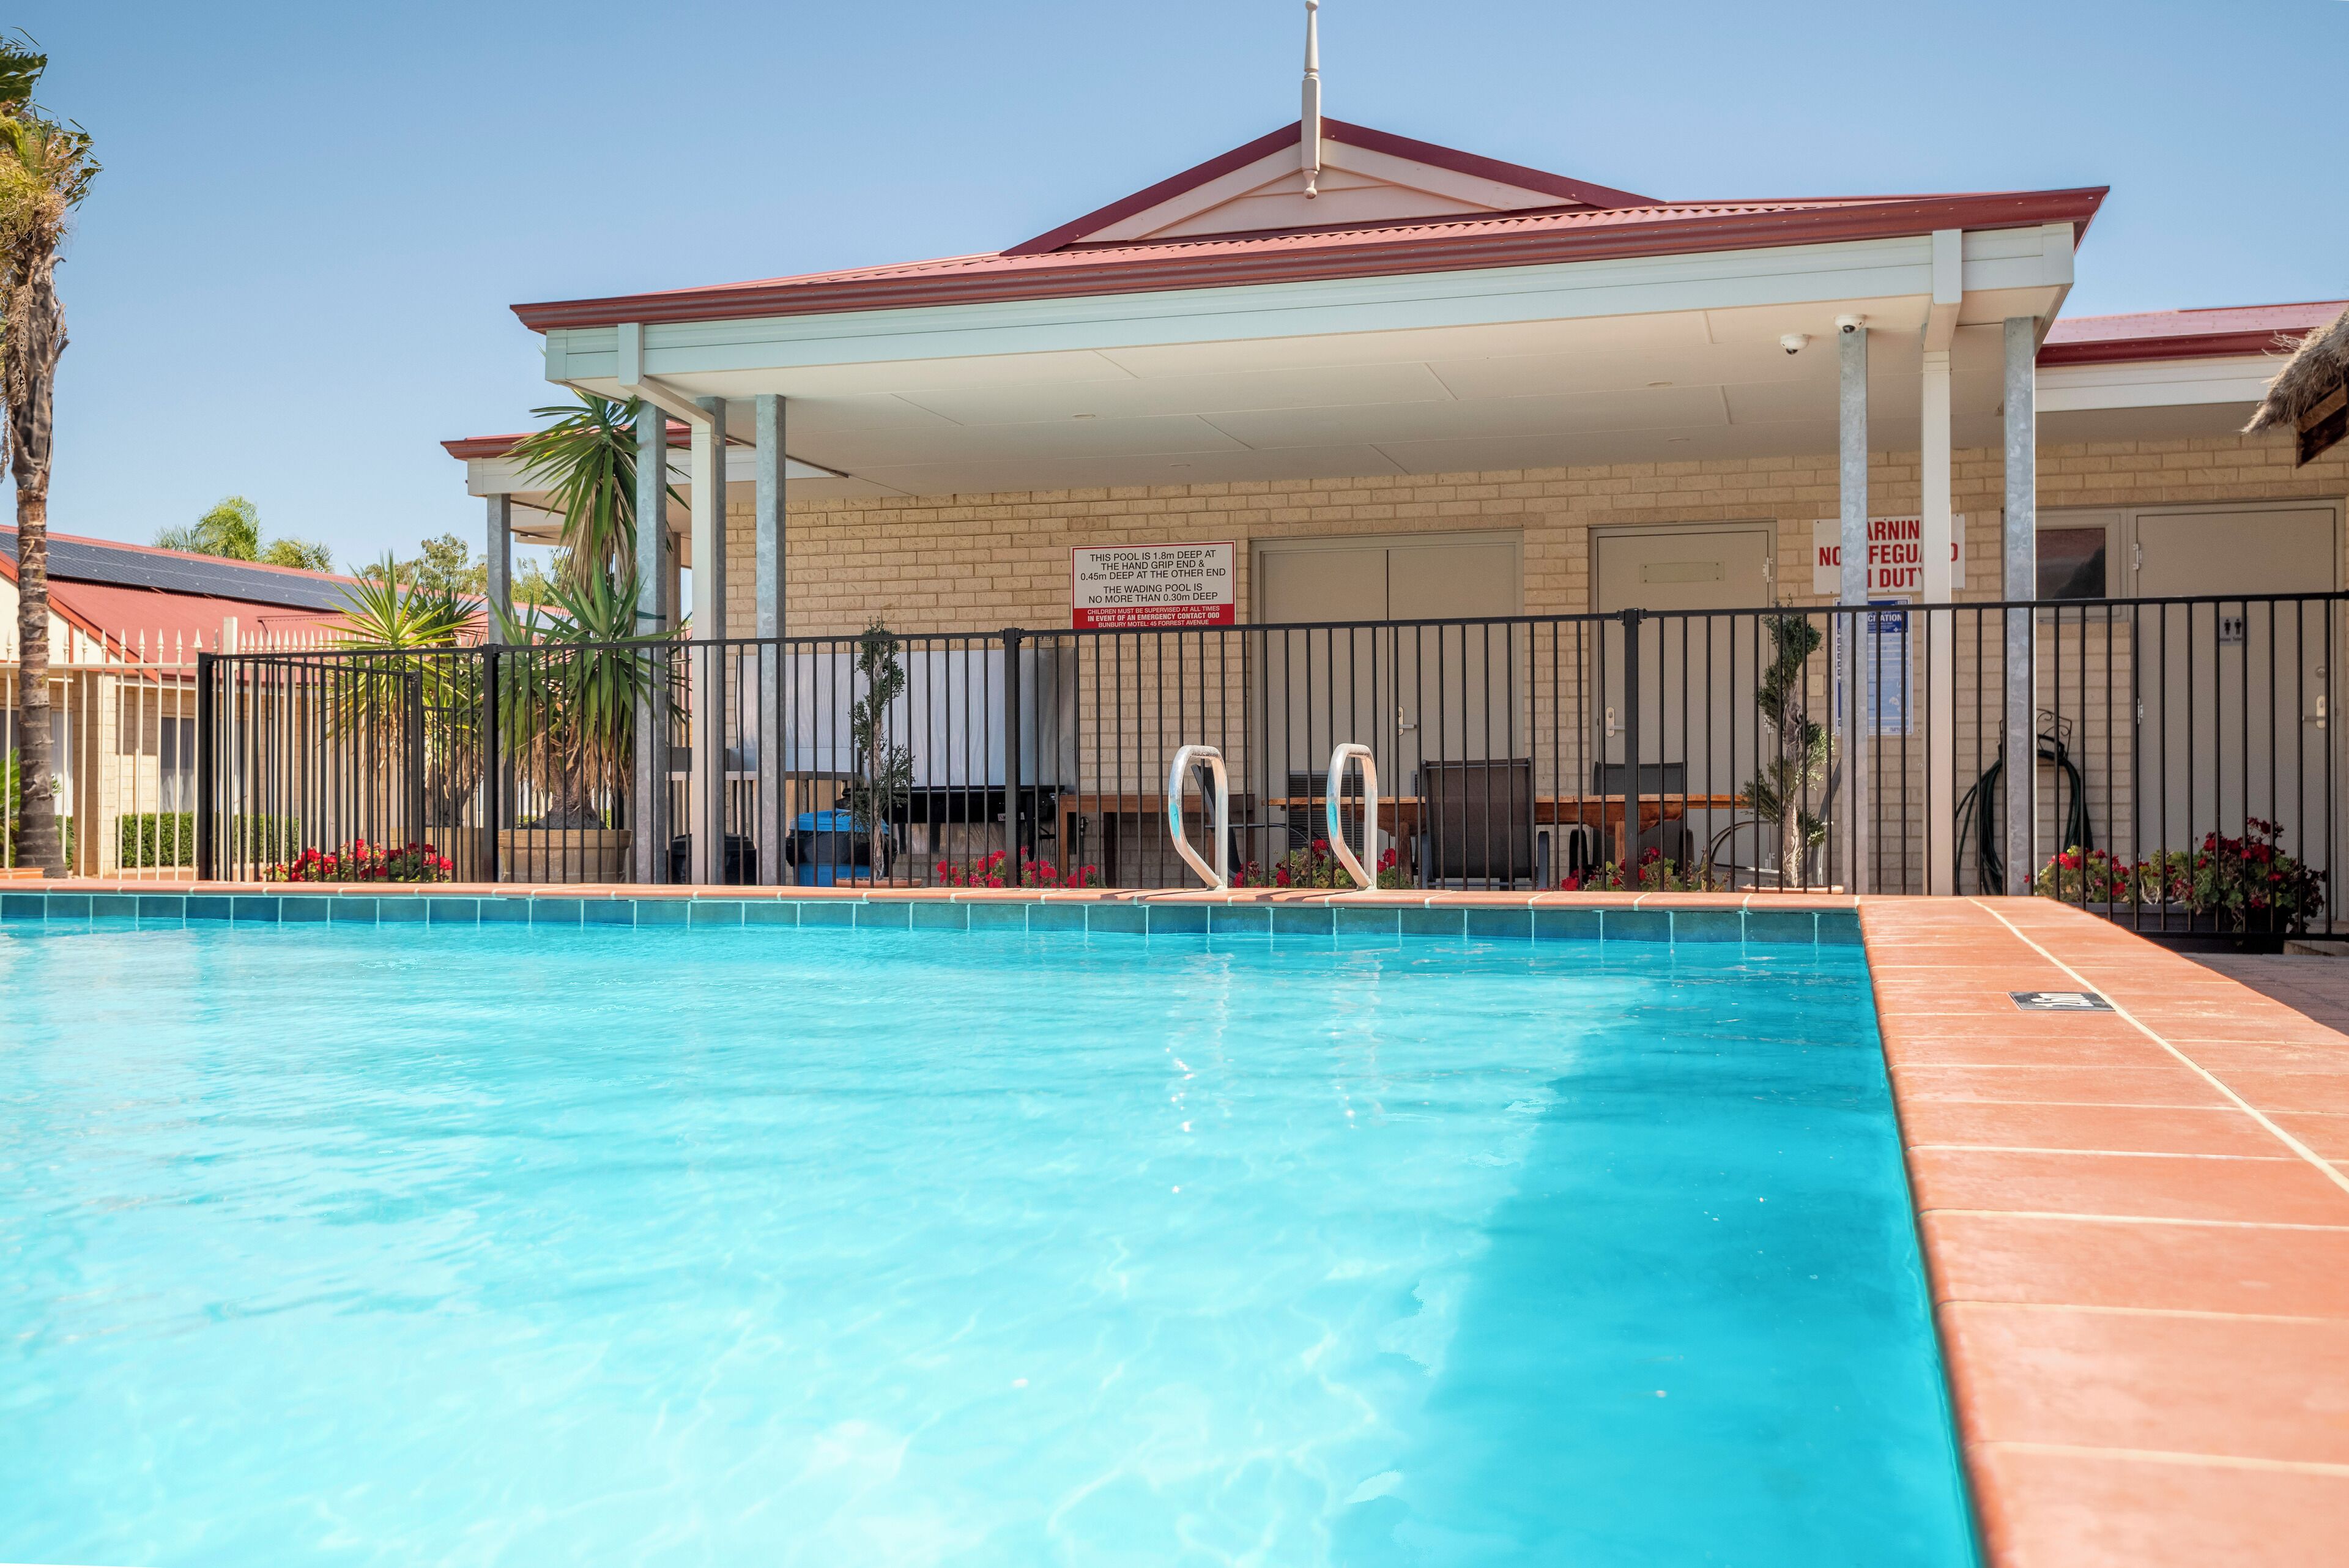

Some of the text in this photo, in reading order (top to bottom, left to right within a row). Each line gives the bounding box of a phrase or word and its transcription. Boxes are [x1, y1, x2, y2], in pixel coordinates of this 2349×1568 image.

[1868, 519, 1920, 541] ARNIN
[1089, 553, 1111, 562] THIS
[1114, 552, 1139, 561] POOL
[1142, 552, 1151, 560] IS
[1178, 551, 1203, 559] DEEP
[1819, 546, 1841, 567] NO
[1101, 562, 1119, 571] THE
[1122, 562, 1148, 570] HAND
[1151, 560, 1174, 570] GRIP
[1176, 560, 1196, 568] END
[1171, 569, 1204, 578] OTHER
[1206, 568, 1226, 576] END
[1103, 583, 1203, 594] THE WADING POOL IS
[1088, 592, 1219, 604] NO MORE THAN 0.30m DEEP
